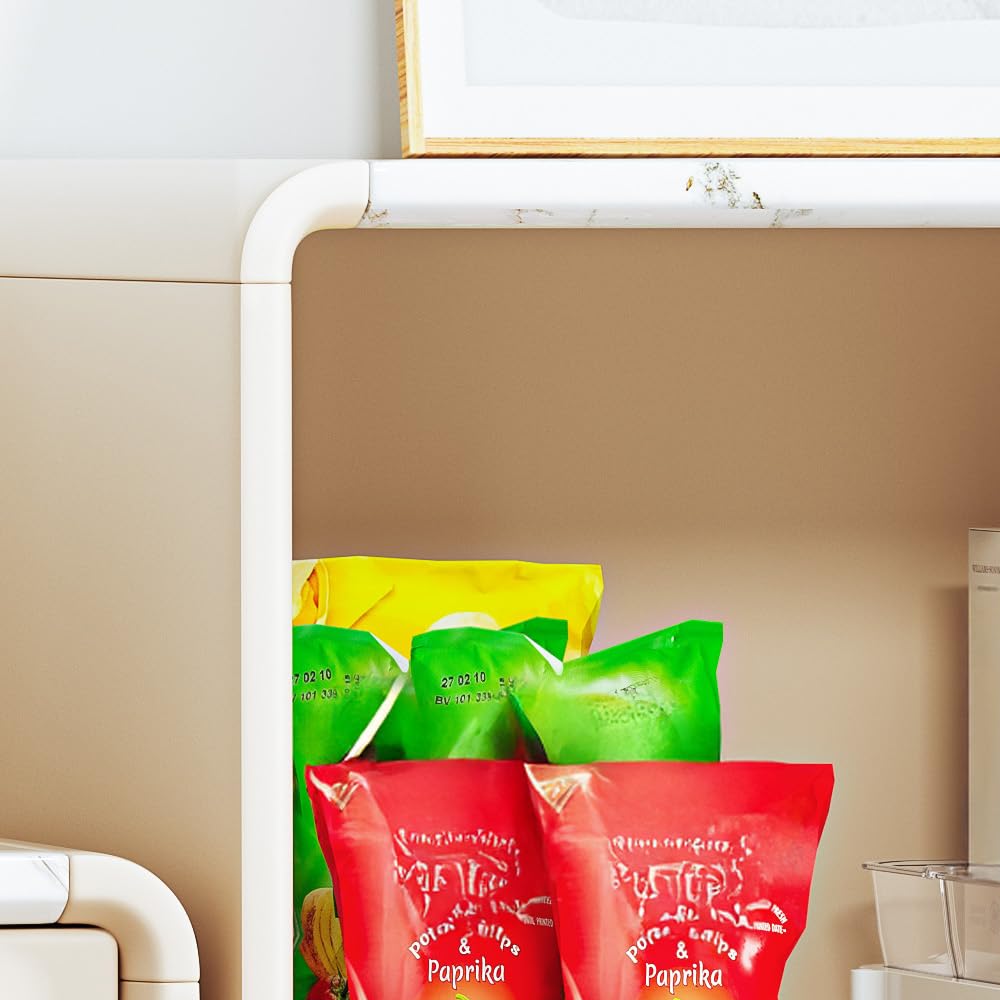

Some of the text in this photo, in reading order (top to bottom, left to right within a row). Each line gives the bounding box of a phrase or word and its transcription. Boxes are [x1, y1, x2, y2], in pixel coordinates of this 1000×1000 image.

[303, 670, 316, 683] 02
[319, 668, 332, 681] 10
[441, 671, 486, 689] 27 02 10
[458, 937, 471, 955] &
[676, 940, 689, 959] &
[428, 955, 506, 990] Paprika
[645, 960, 723, 994] Paprika
